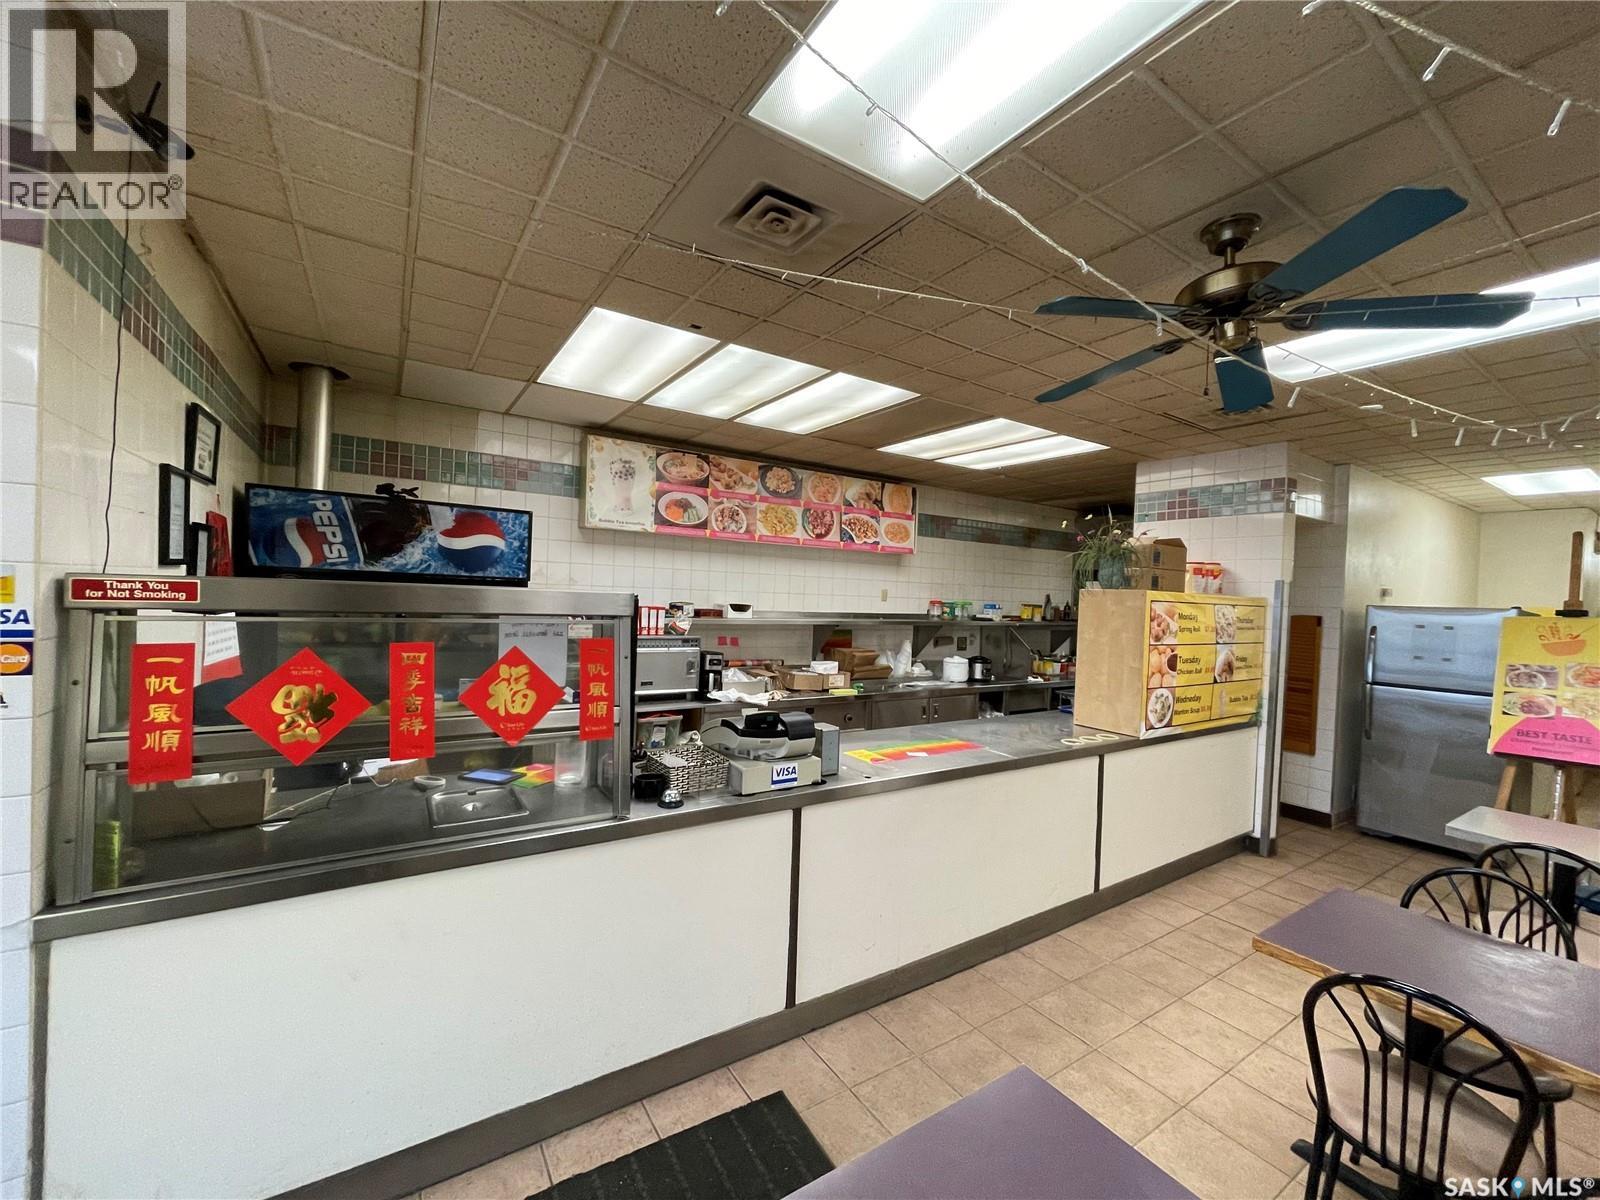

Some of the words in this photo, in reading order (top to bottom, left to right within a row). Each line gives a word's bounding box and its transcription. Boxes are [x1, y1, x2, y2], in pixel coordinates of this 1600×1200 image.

[308, 499, 349, 562] PEPSI
[104, 580, 143, 589] Thank
[147, 582, 169, 590] You
[85, 589, 104, 598] for
[107, 590, 130, 598] Not
[133, 590, 187, 601] Smoking
[1178, 612, 1199, 623] Monday
[1178, 655, 1201, 665] Tuesday
[399, 652, 428, 737] 四季吉祥
[486, 663, 537, 717] 福
[141, 656, 186, 753] 一帆風順
[1516, 728, 1549, 739] BEST
[1552, 732, 1593, 745] TASTE
[775, 766, 797, 777] VISA
